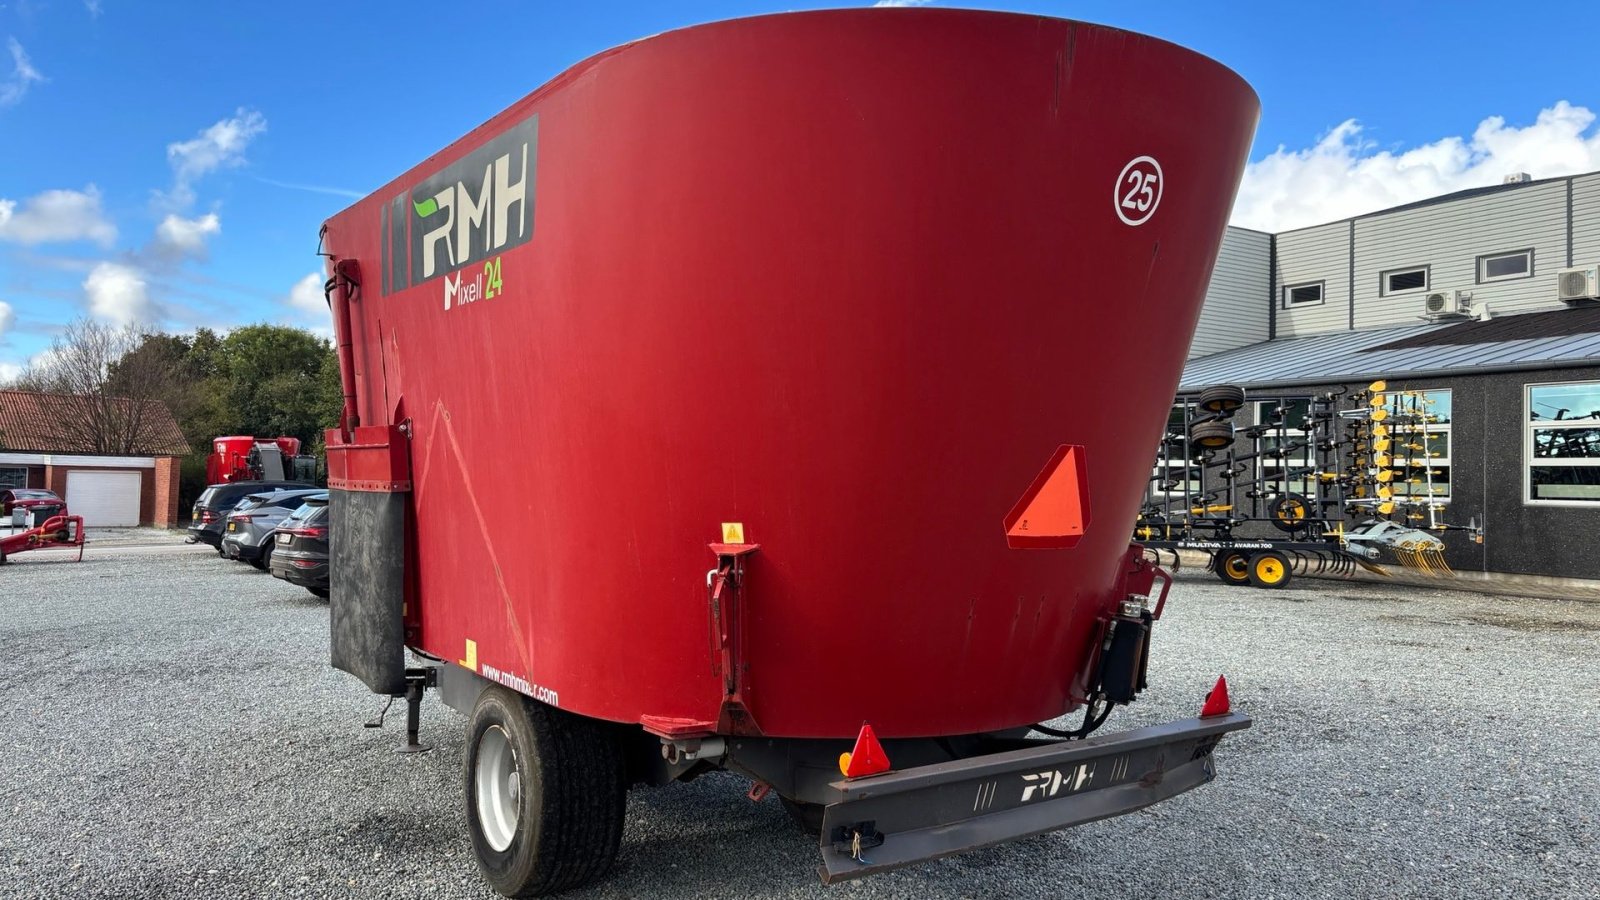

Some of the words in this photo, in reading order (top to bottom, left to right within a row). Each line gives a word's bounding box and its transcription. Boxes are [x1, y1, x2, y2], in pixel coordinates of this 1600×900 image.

[413, 143, 528, 278] RMH
[1121, 170, 1157, 212] 25
[444, 270, 482, 311] Mixell
[484, 256, 503, 300] 24
[1021, 762, 1097, 802] RMH
